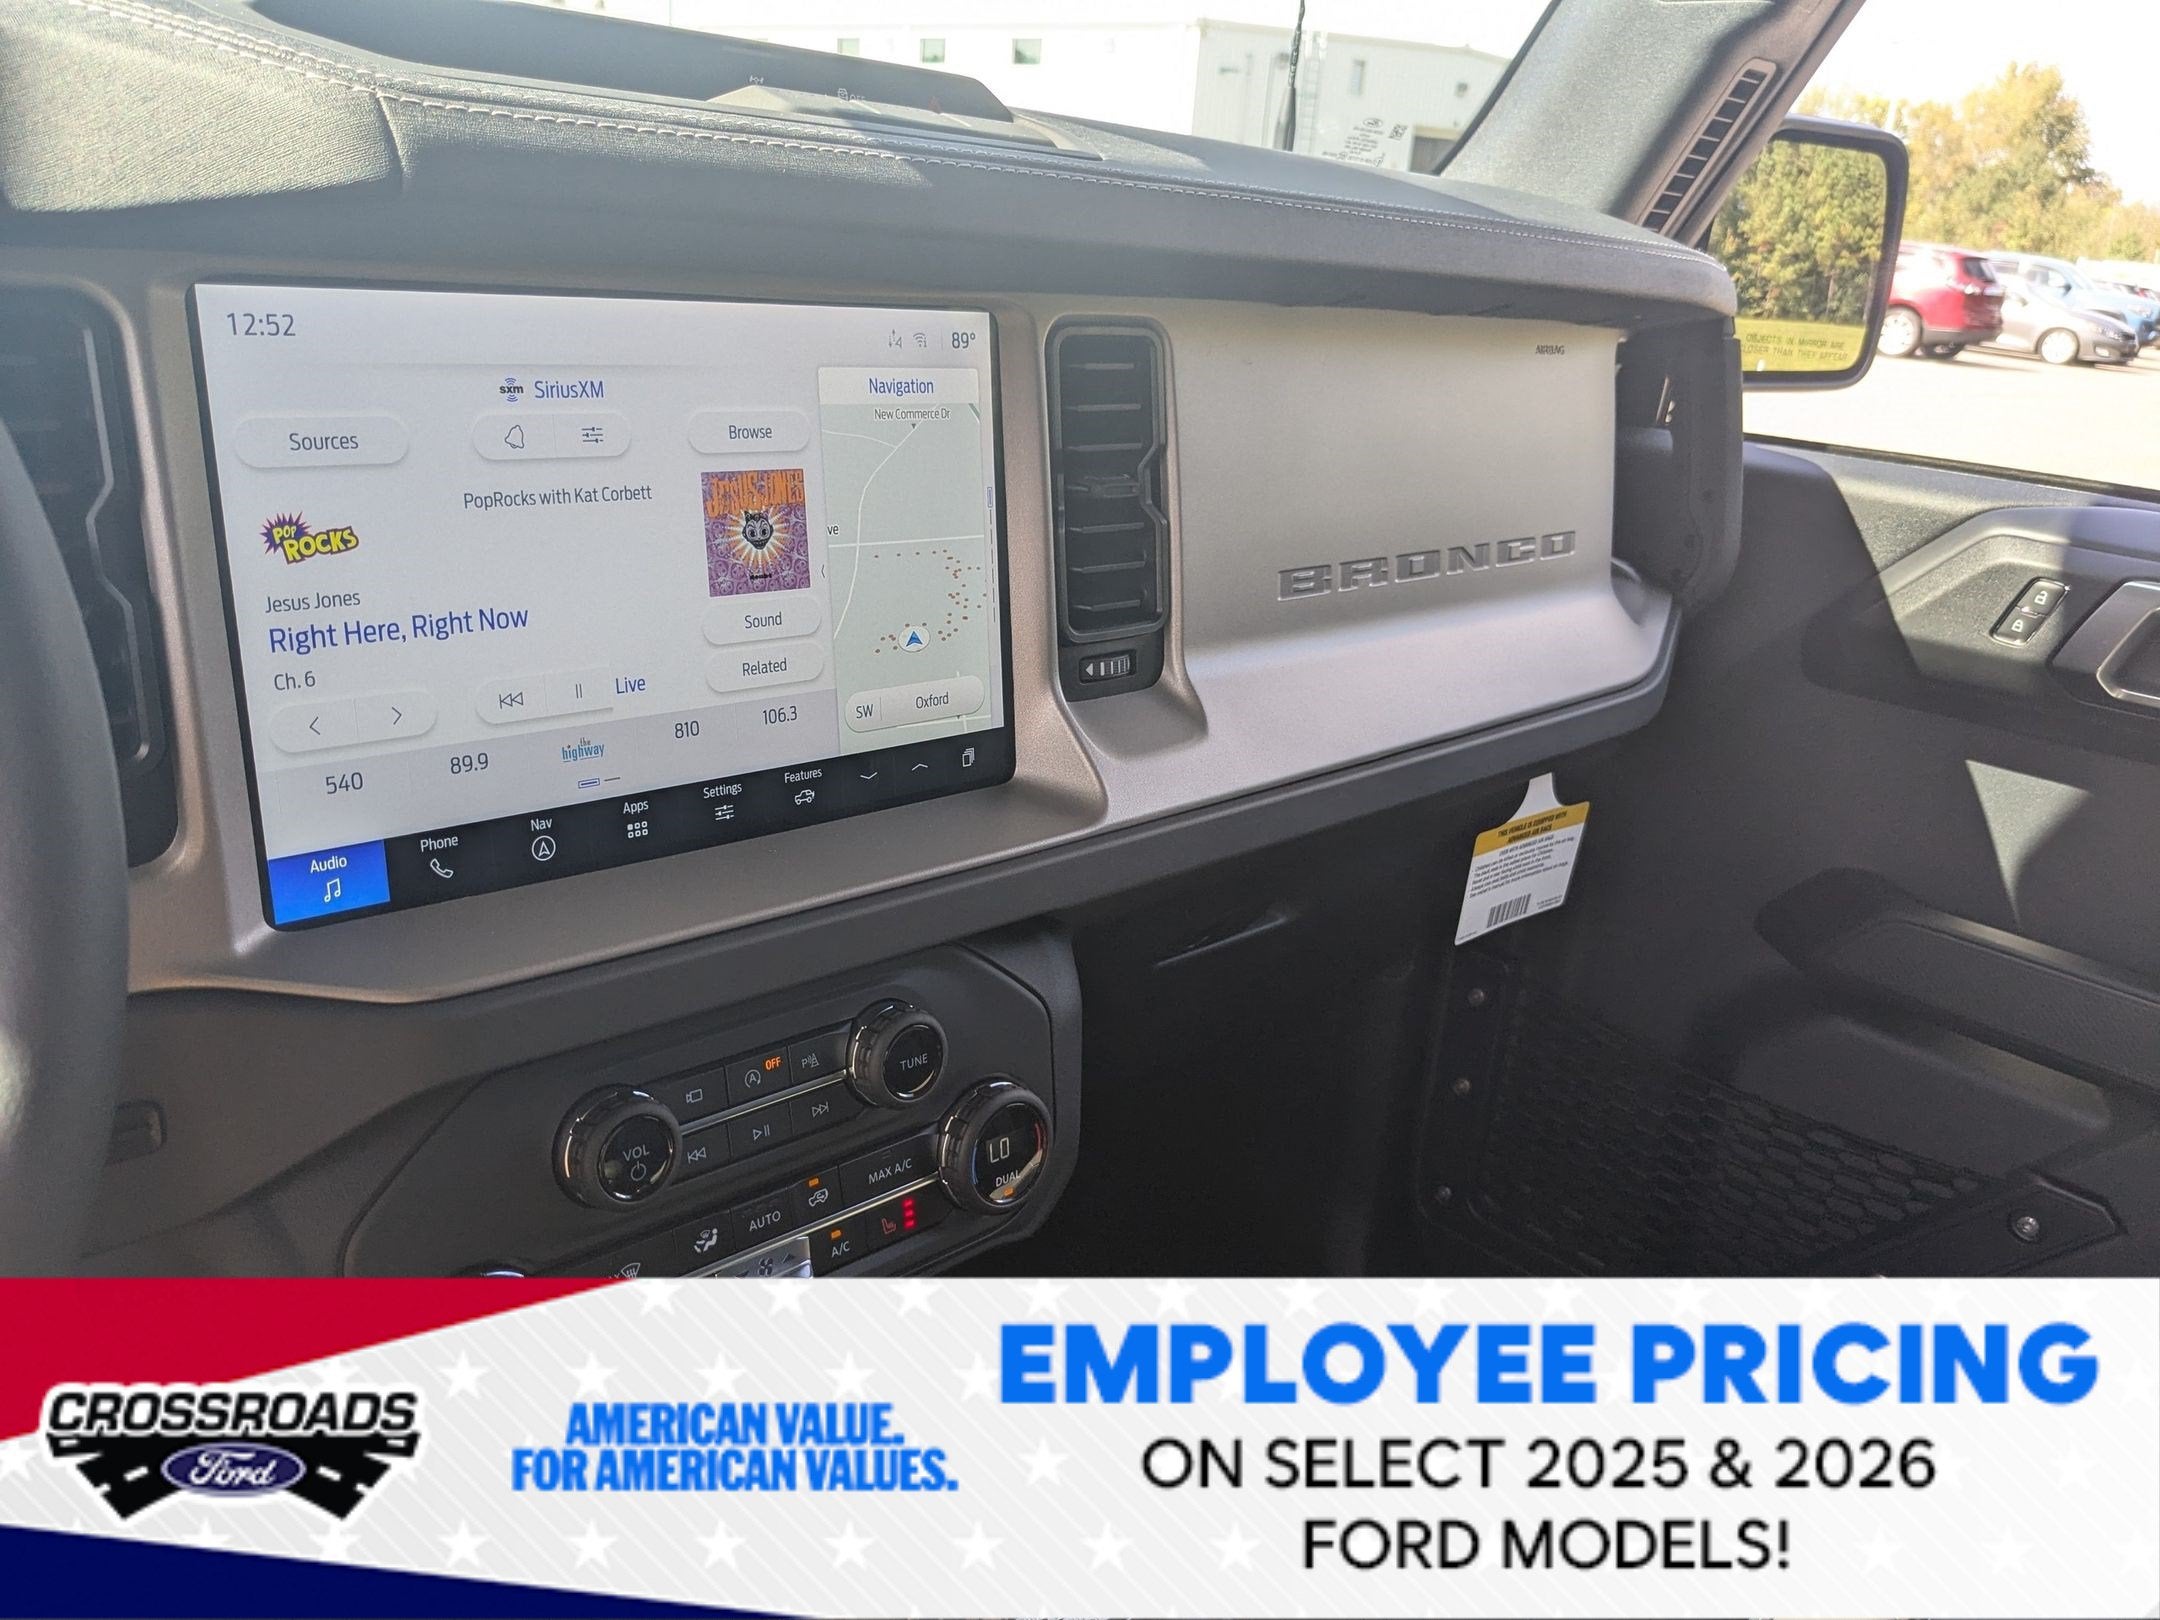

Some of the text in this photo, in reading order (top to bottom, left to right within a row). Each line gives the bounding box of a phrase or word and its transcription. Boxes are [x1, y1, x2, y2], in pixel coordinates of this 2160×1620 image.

[226, 312, 296, 337] 12:52
[951, 331, 976, 350] 89°
[1535, 344, 1565, 356] AIRBAG
[499, 385, 524, 395] sxm
[534, 380, 605, 400] SiriusXM
[869, 378, 934, 397] Navigation
[874, 408, 951, 420] New Commerce Dr
[289, 432, 359, 451] Sources
[728, 425, 772, 440] Browse
[464, 485, 652, 511] PopRocks with Kat Corbett
[272, 524, 297, 545] POP
[282, 526, 359, 564] ROCKS
[1278, 530, 1576, 601] BRONCO
[265, 592, 361, 614] Jesus Jones
[744, 612, 782, 629] Sound
[269, 607, 529, 655] Right Here, Right Now
[742, 658, 787, 677] Related
[273, 670, 316, 691] Ch. 6
[615, 676, 646, 695] Live
[915, 692, 949, 709] Oxford
[762, 705, 798, 726] 106.3
[855, 703, 874, 719] SW
[674, 720, 700, 740] 810
[580, 737, 591, 747] the
[562, 744, 605, 761] highway
[449, 752, 489, 774] 89.9
[325, 771, 364, 795] 540
[784, 766, 822, 784] Features
[703, 781, 742, 799] Settings
[622, 799, 649, 815] Apps
[530, 816, 553, 831] Nav
[419, 834, 459, 853] Phone
[309, 855, 348, 873] Audio
[764, 1055, 781, 1071] OFF
[900, 1052, 928, 1071] TUNE
[622, 1145, 650, 1162] VOL
[989, 1137, 1010, 1163] LO
[868, 1157, 913, 1184] MAX A/C
[995, 1169, 1021, 1188] DUAL
[749, 1210, 782, 1232] AUTO
[831, 1240, 851, 1258] A/C
